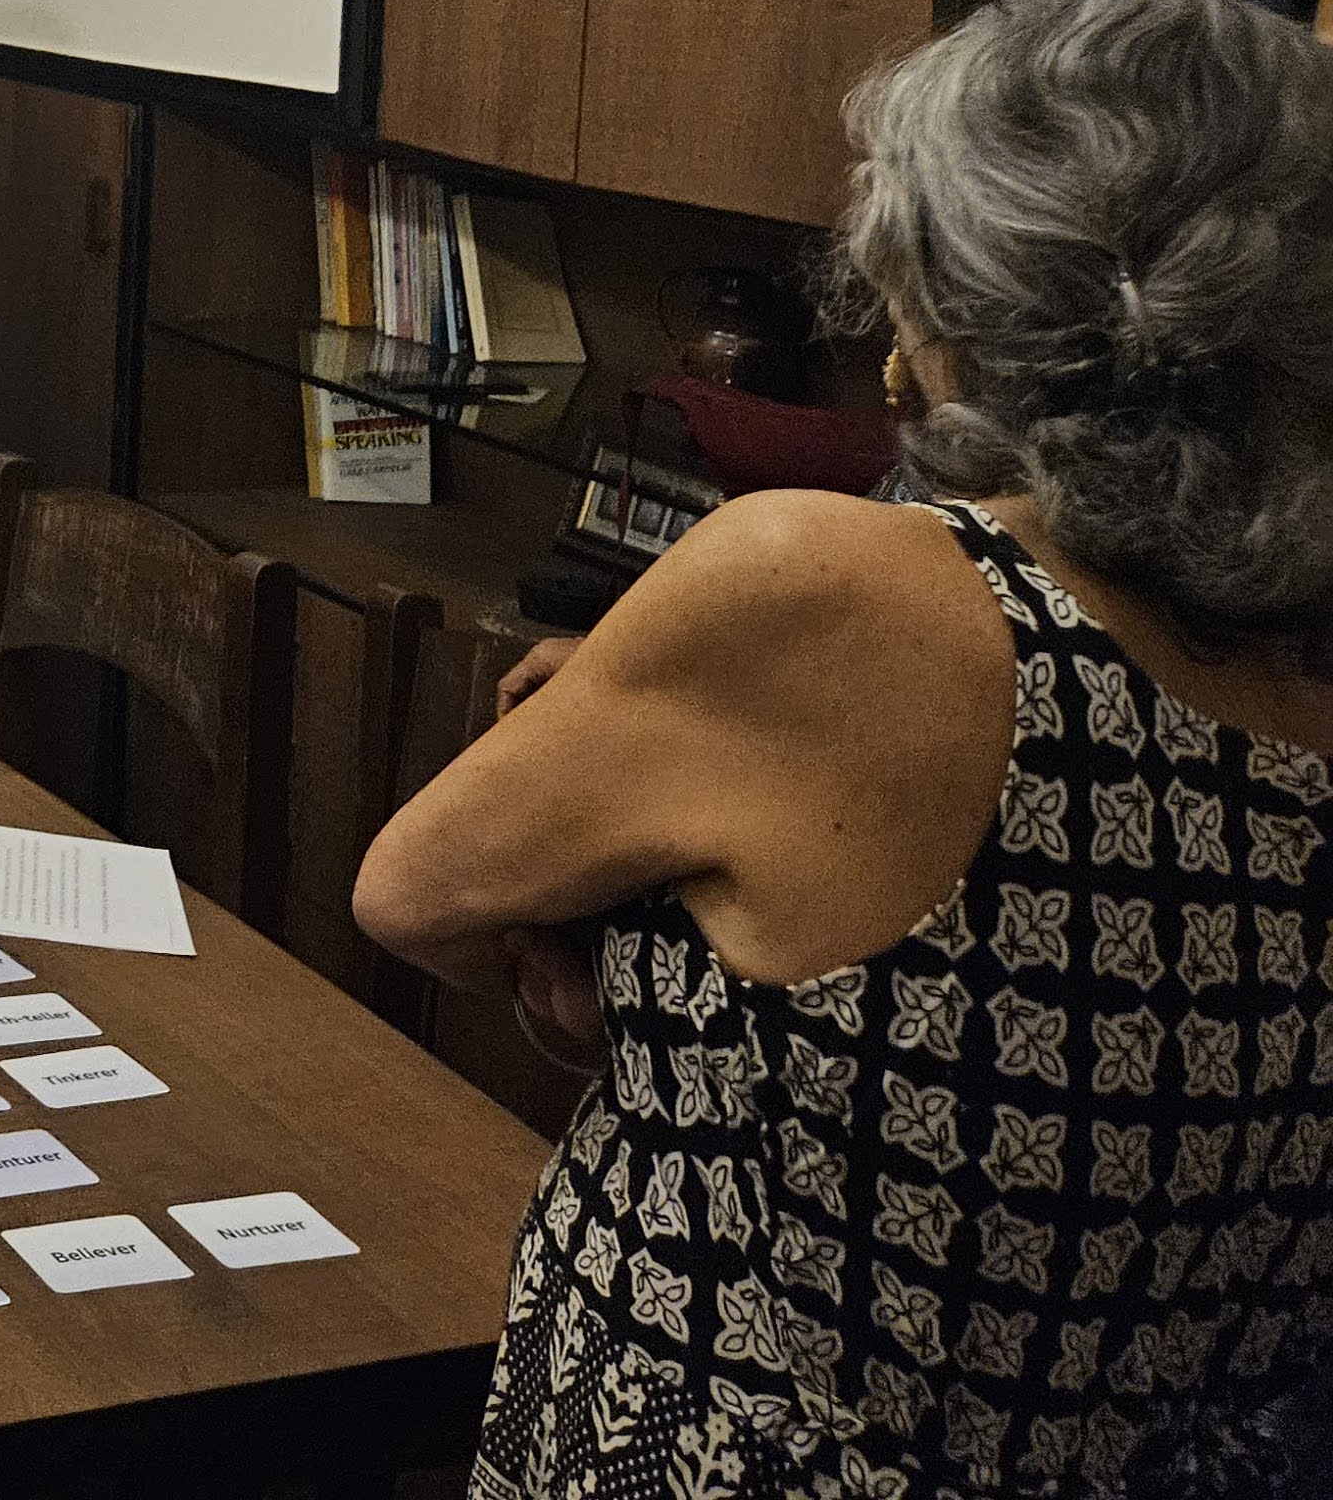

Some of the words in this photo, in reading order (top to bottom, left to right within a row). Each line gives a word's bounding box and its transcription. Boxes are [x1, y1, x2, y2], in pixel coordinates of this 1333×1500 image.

[334, 430, 422, 451] SPEAKING
[41, 1068, 120, 1086] Tinkerer
[216, 1220, 307, 1241] Nurturer
[50, 1243, 139, 1264] Believer
